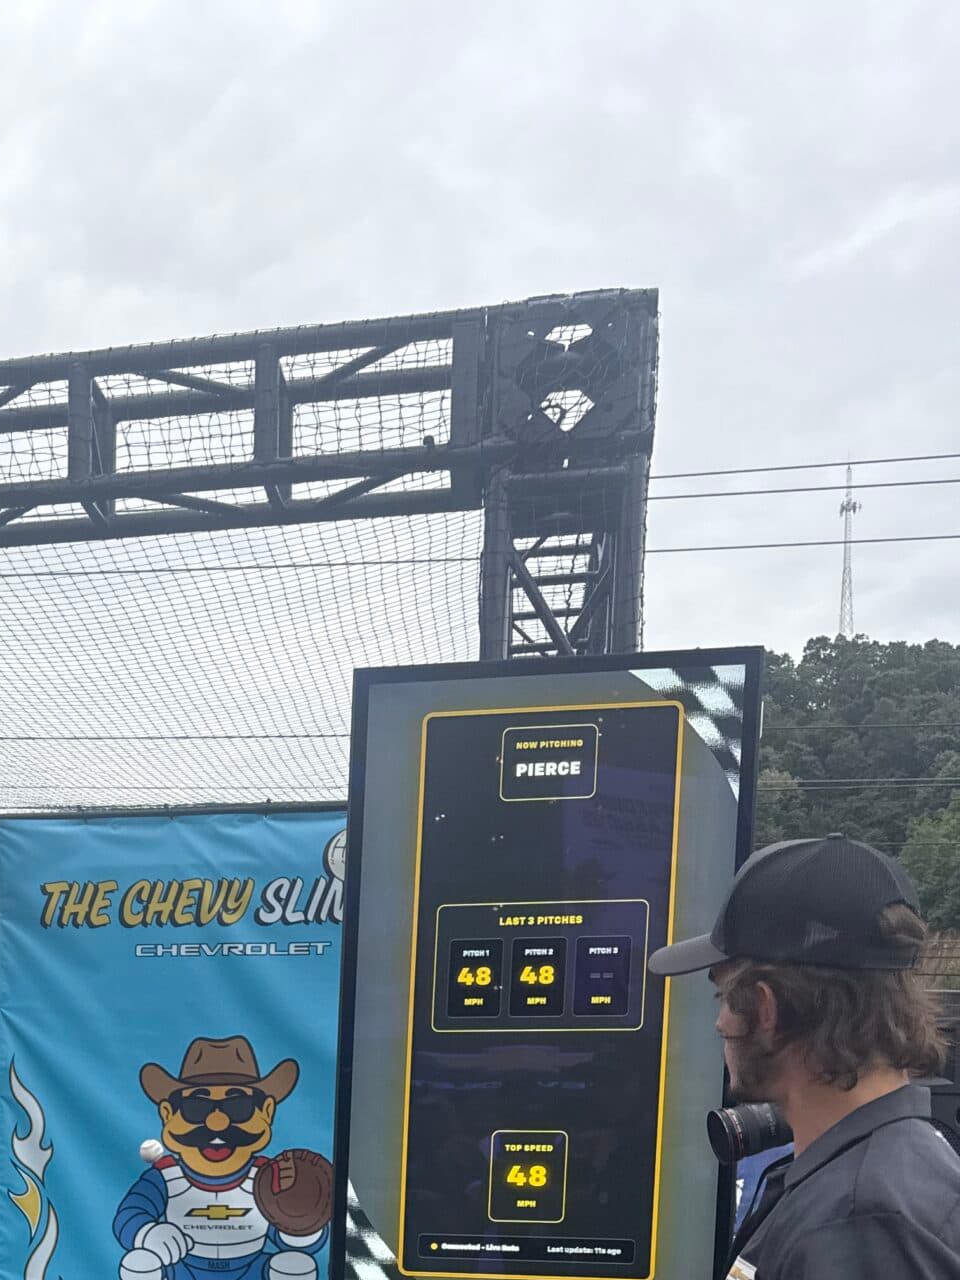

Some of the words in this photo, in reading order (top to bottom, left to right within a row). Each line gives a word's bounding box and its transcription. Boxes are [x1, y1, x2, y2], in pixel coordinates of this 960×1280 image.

[516, 741, 539, 750] NOW
[540, 739, 584, 749] PITCHING
[516, 761, 581, 777] PIERCE
[41, 880, 118, 928] THE
[120, 877, 255, 929] CHEVY
[499, 916, 527, 926] LAST
[527, 916, 535, 925] 3
[536, 915, 583, 925] PITCHES
[135, 942, 332, 957] CHEVROLET
[462, 949, 485, 957] PITCH
[485, 949, 490, 957] 1
[524, 948, 547, 956] PITCH
[589, 947, 612, 955] PITCH
[457, 966, 492, 986] 48
[519, 965, 555, 985] 48
[464, 998, 484, 1006] MPH
[526, 997, 547, 1005] MPH
[591, 996, 612, 1004] MPH
[504, 1144, 523, 1152] TOP
[524, 1144, 554, 1152] SPEED
[506, 1165, 547, 1187] 48
[516, 1200, 537, 1208] MPH
